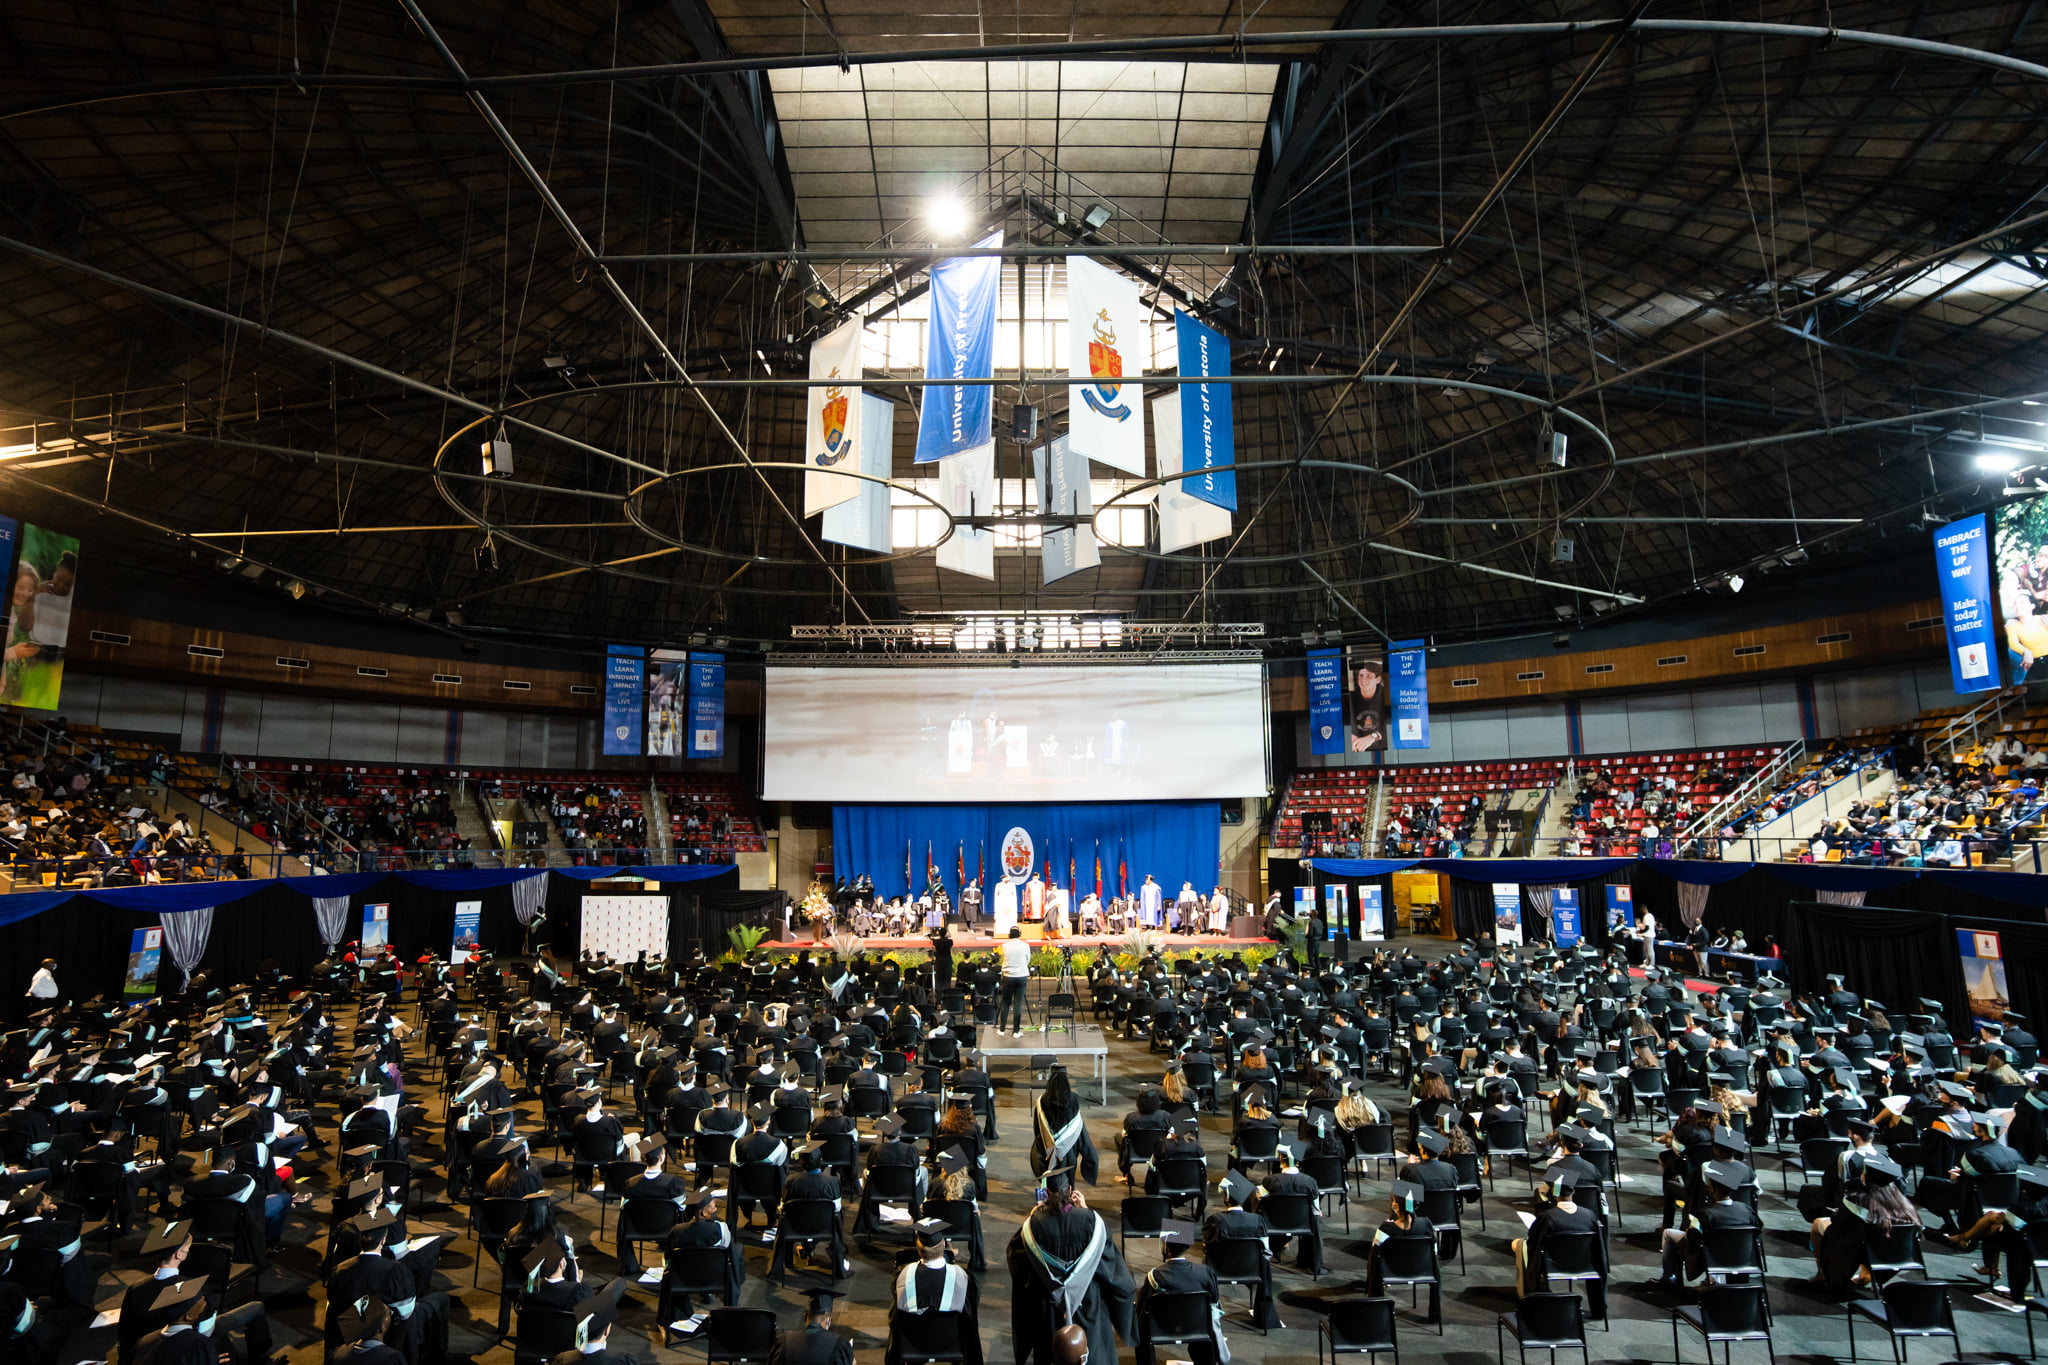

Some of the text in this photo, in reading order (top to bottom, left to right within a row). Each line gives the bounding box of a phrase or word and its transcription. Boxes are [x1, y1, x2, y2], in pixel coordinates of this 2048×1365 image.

[955, 333, 966, 350] of
[1199, 335, 1208, 394] Petoria
[952, 354, 967, 442] Univerity
[1201, 394, 1209, 412] of
[1937, 528, 1981, 547] EMBRACE
[1950, 543, 1969, 555] THE
[1953, 556, 1967, 567] UP
[1951, 566, 1971, 578] WAY
[1953, 598, 1977, 611] Make
[1954, 610, 1978, 622] today
[1953, 620, 1983, 632] matter
